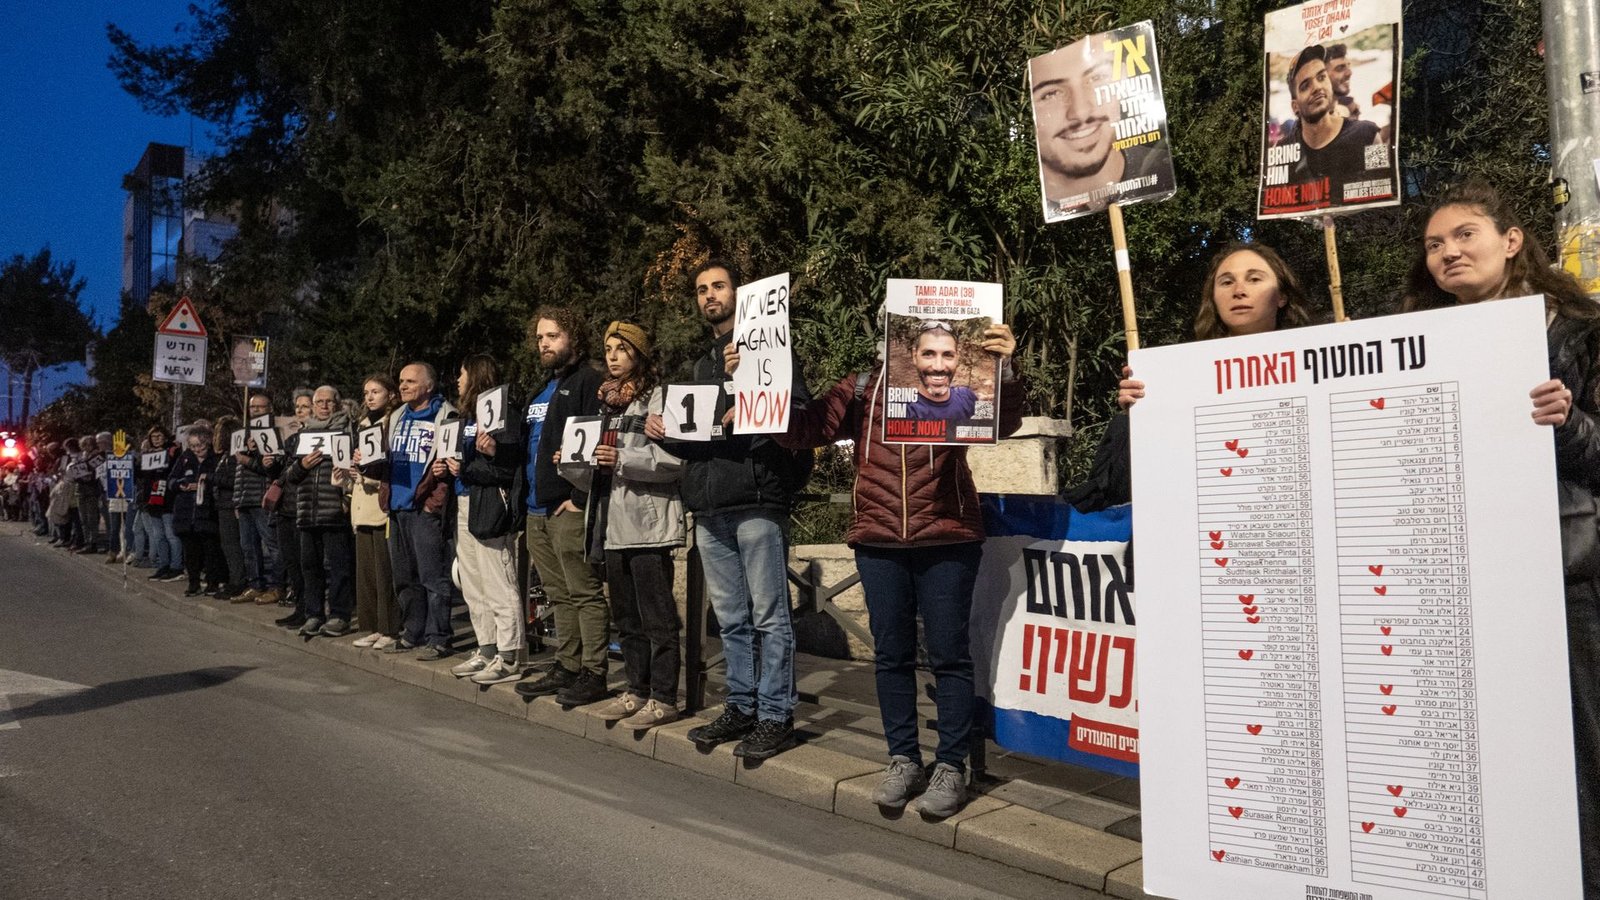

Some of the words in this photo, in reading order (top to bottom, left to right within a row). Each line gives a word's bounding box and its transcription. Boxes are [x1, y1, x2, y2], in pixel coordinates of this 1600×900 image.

[1305, 16, 1324, 30] YOSEF
[1326, 9, 1350, 24] OHANA
[1318, 25, 1332, 40] (24)
[1103, 34, 1151, 80] אל
[1094, 73, 1154, 106] תשאירו
[1110, 115, 1160, 141] מאחור
[1267, 143, 1300, 167] BRING
[1266, 165, 1289, 186] HIM
[1264, 184, 1299, 206] HOME
[1300, 176, 1330, 203] NOW!
[914, 285, 937, 296] TAMIR
[939, 286, 958, 297] ADAR
[960, 287, 975, 299] (38)
[917, 298, 944, 306] MURDERED
[953, 299, 972, 307] HAMAS
[908, 305, 922, 314] STILL
[923, 306, 935, 314] HELD
[936, 306, 959, 315] HOSTAGE
[960, 307, 966, 315] IN
[966, 307, 980, 315] GAZA
[166, 340, 196, 352] חדש
[736, 324, 786, 354] AGAIN
[1391, 335, 1426, 371] עד
[1303, 340, 1383, 384] החטוף
[164, 365, 194, 376] NEW
[757, 358, 773, 386] IS
[1214, 351, 1296, 394] האחרון
[887, 387, 918, 403] BRING
[483, 399, 495, 429] 3
[679, 393, 698, 433] 1
[738, 388, 788, 429] NOW
[887, 403, 907, 418] HIM
[886, 420, 915, 435] HOME
[917, 419, 946, 436] NOW!
[1452, 423, 1458, 431] 4
[260, 432, 273, 453] 8
[311, 436, 325, 451] 7
[365, 433, 375, 457] 5
[443, 428, 451, 453] 4
[570, 428, 587, 462] 2
[1453, 443, 1459, 451] 6
[337, 439, 344, 462] 6
[149, 454, 162, 467] 14
[1454, 463, 1460, 471] 8
[1452, 494, 1461, 502] 11
[1452, 504, 1463, 512] 12
[1022, 547, 1135, 626] אותם
[1456, 586, 1467, 594] 20
[1459, 648, 1471, 656] 26
[1019, 623, 1139, 712] כשיו!
[1462, 690, 1473, 698] 30
[1308, 701, 1318, 709] 80
[1463, 711, 1474, 719] 32
[1076, 726, 1117, 749] והנעדרים
[1434, 730, 1458, 738] אריאל
[1464, 732, 1475, 740] 34
[1310, 759, 1320, 767] 86
[1434, 791, 1461, 801] דניאלה
[1467, 795, 1479, 803] 40
[1313, 818, 1323, 826] 92
[1469, 826, 1481, 835] 43
[1469, 837, 1481, 845] 44
[1314, 847, 1324, 856] 95
[1315, 867, 1325, 876] 97
[1448, 877, 1466, 886] שירי
[1471, 879, 1483, 888] 48
